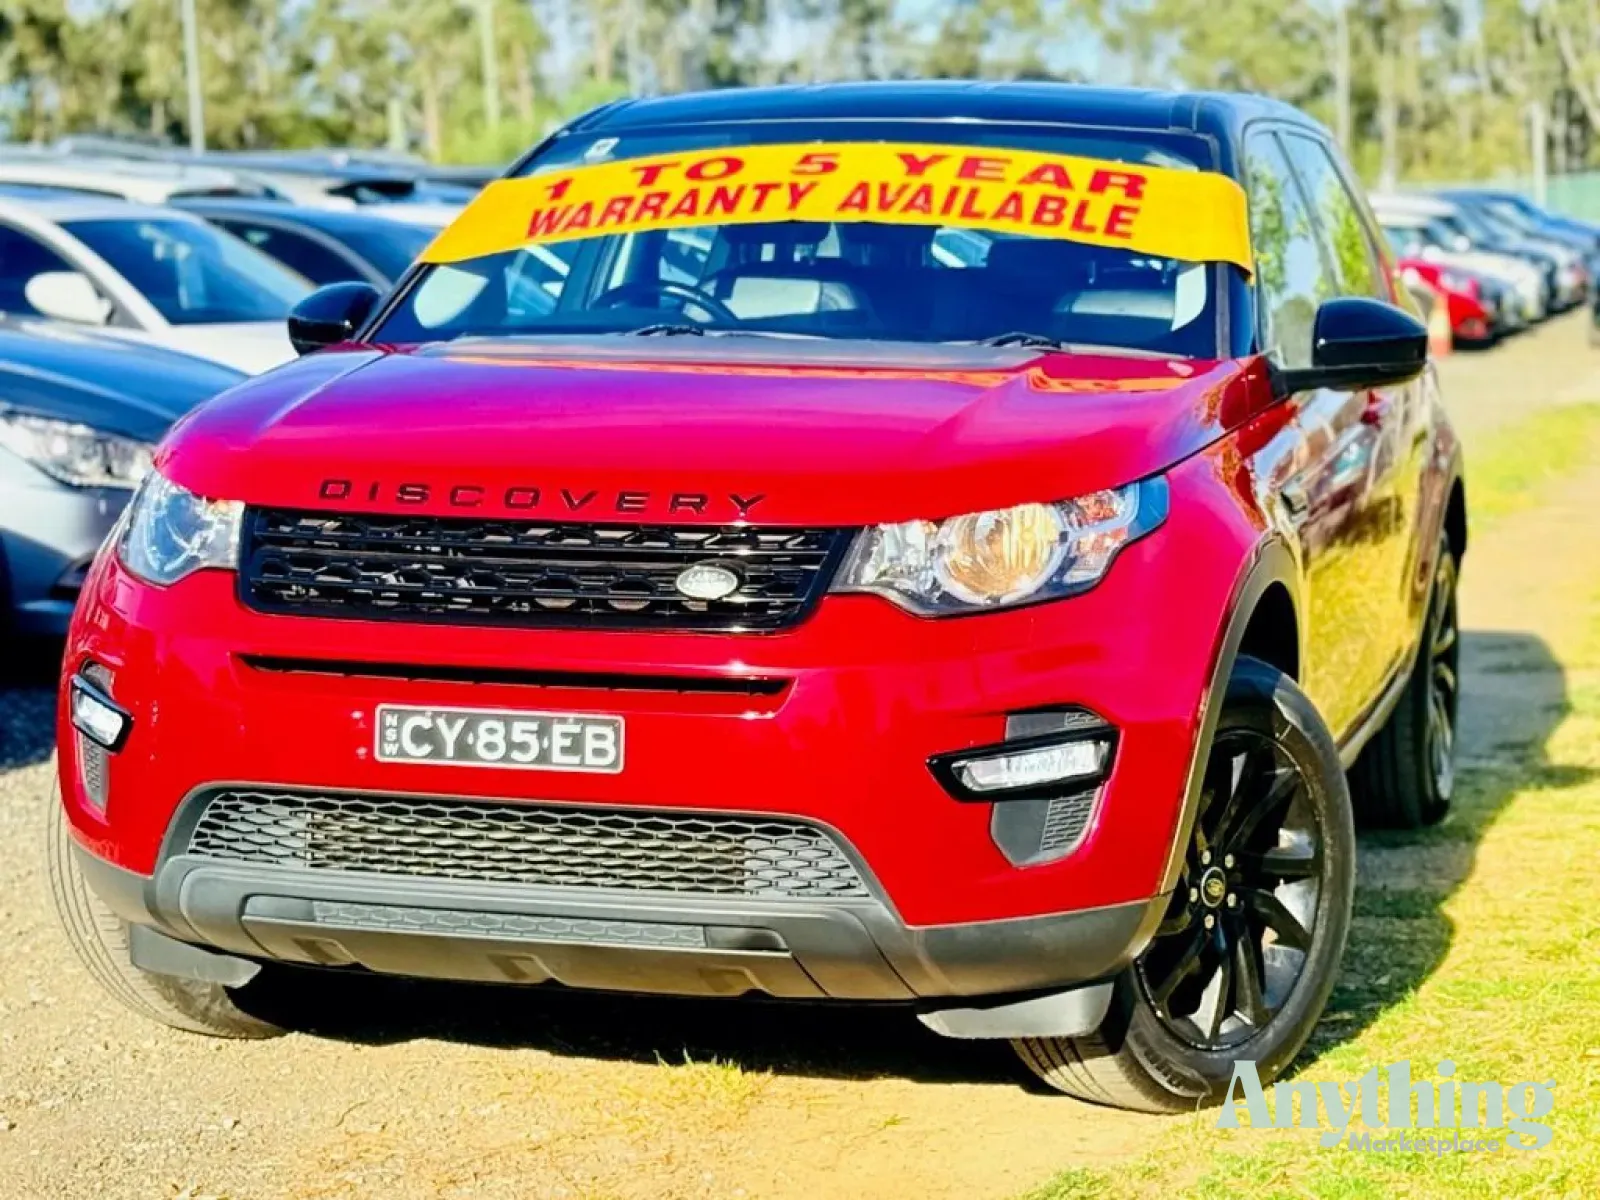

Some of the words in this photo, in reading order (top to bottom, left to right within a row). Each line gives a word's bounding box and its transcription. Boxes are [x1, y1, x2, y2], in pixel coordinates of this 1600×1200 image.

[545, 179, 573, 201] 1
[631, 157, 745, 187] TO
[790, 154, 839, 175] 5
[898, 153, 1147, 198] YEAR
[527, 182, 819, 238] WARRANTY
[837, 182, 1140, 238] AVAILABLE
[319, 479, 765, 516] DISCOVERY
[385, 714, 399, 756] NSW
